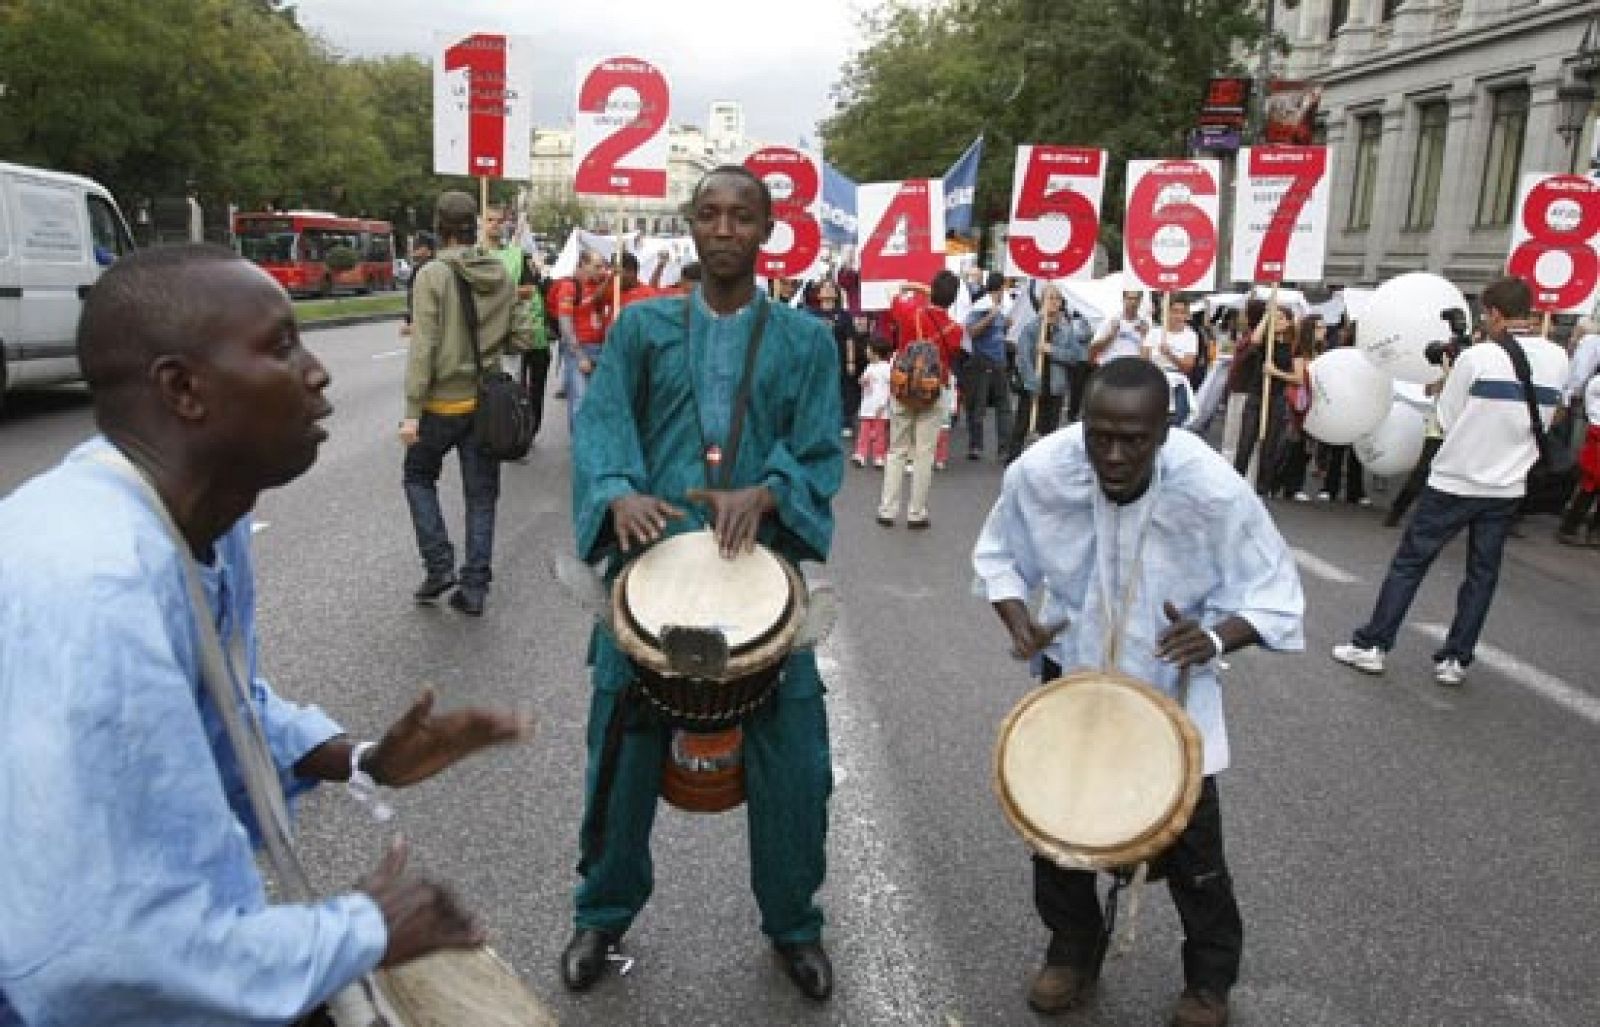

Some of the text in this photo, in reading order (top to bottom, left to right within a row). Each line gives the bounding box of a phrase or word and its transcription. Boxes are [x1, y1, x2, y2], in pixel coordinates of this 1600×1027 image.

[445, 34, 507, 176] 1
[575, 56, 670, 196] 2
[745, 146, 821, 278] 3
[860, 180, 946, 282] 4
[1008, 145, 1101, 279] 5
[1127, 161, 1217, 291] 6
[1249, 145, 1327, 282] 7
[1510, 174, 1600, 310] 8
